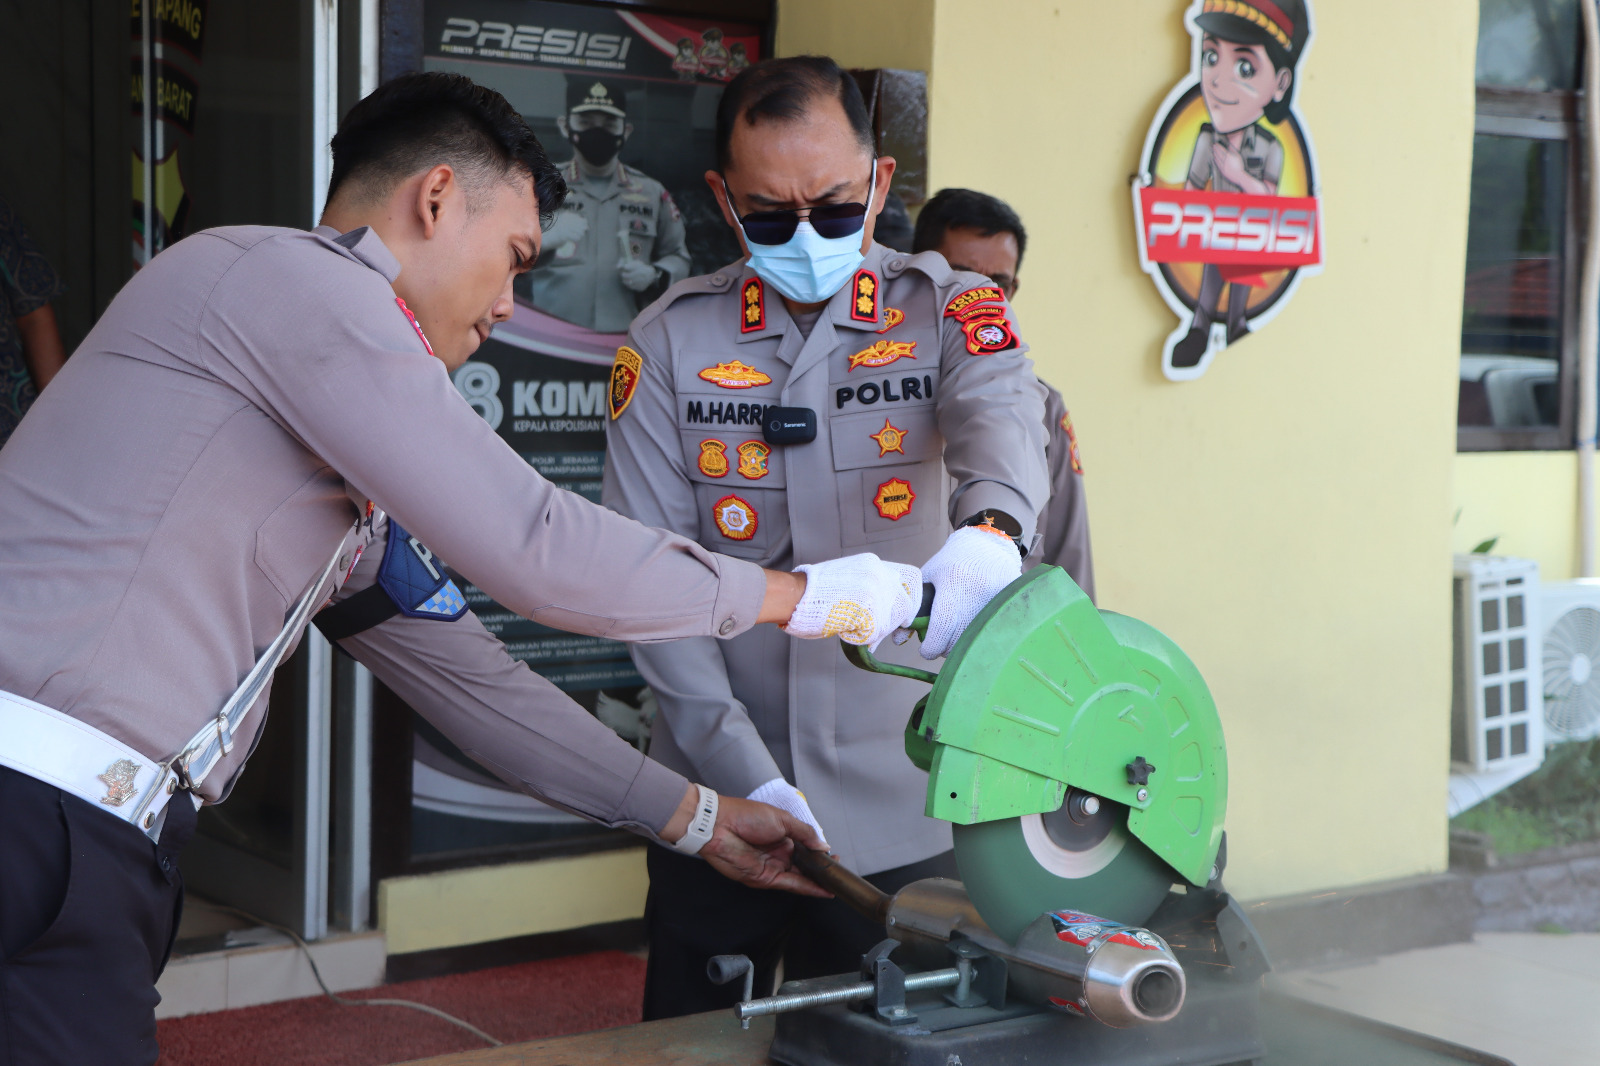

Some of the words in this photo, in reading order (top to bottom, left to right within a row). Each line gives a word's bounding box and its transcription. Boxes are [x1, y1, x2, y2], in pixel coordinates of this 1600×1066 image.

[441, 18, 631, 60] PRESISI
[157, 77, 192, 120] BARAT
[619, 204, 653, 217] POLRI
[1148, 201, 1316, 254] PRESISI
[512, 380, 609, 417] KOM
[837, 375, 933, 409] POLRI
[514, 420, 547, 432] KEPALA
[550, 420, 599, 433] KEPOLISIAN
